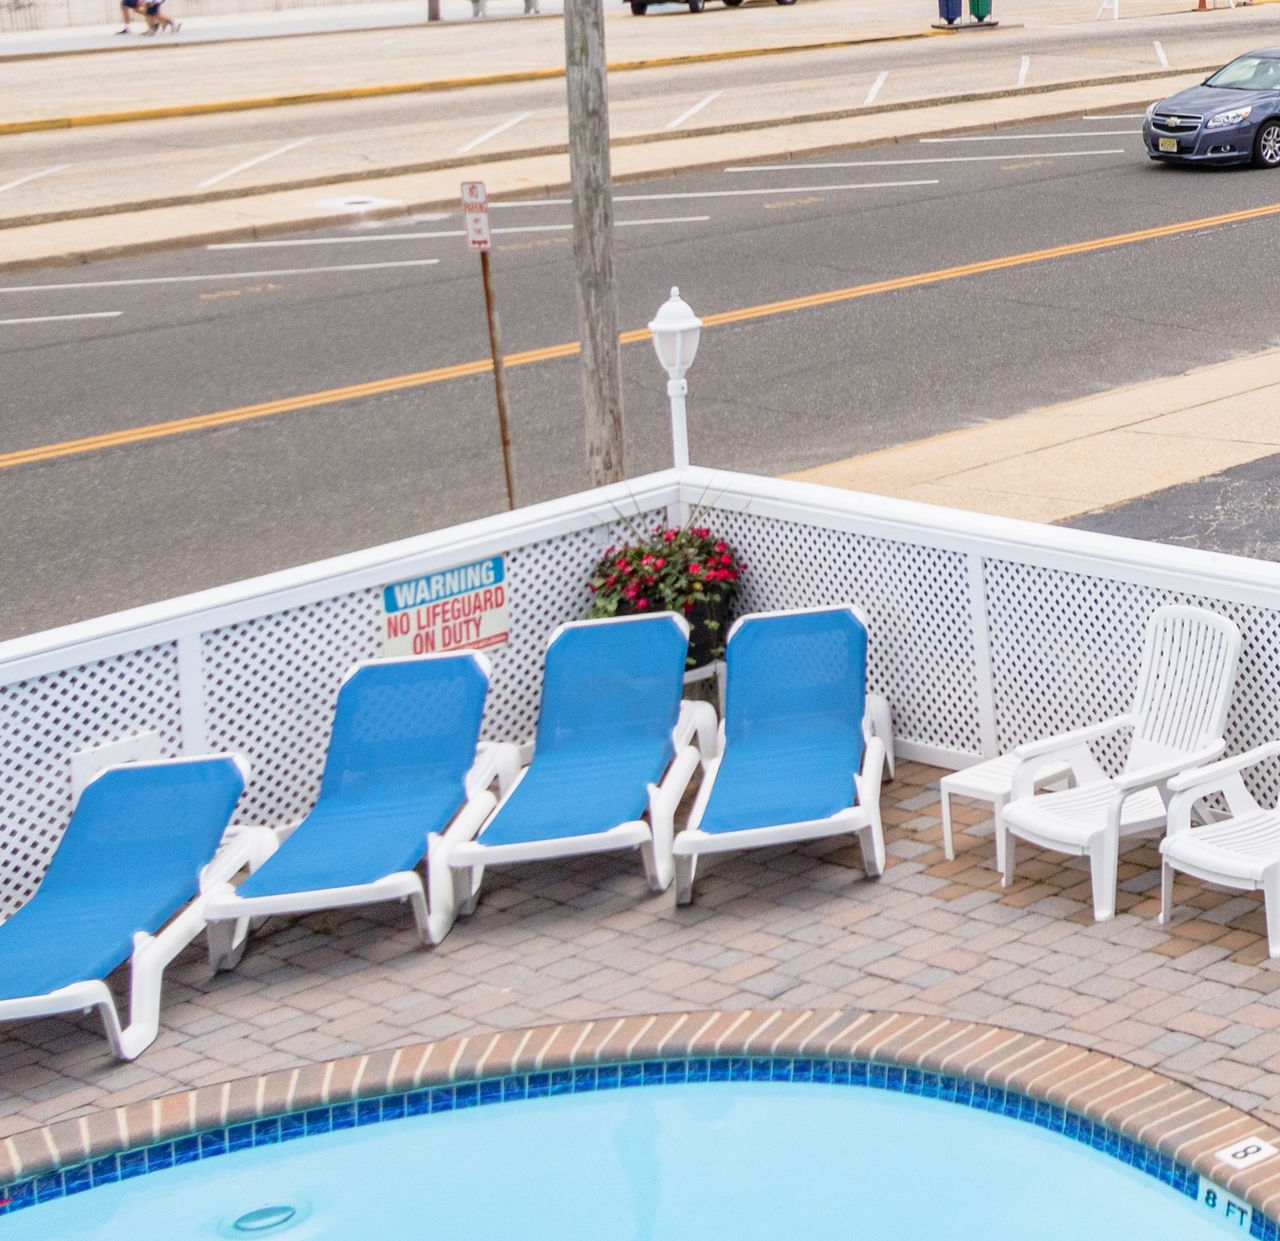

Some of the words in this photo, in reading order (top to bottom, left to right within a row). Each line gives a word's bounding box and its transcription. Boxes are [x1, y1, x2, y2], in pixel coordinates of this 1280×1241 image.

[394, 560, 495, 608] WARNING
[387, 612, 410, 639] NO
[417, 585, 505, 631] LIFEGUARD
[413, 630, 435, 655] ON
[442, 616, 482, 648] DUTY
[1231, 1144, 1263, 1160] 8
[1204, 1188, 1218, 1208] 8
[1225, 1200, 1249, 1226] FT
